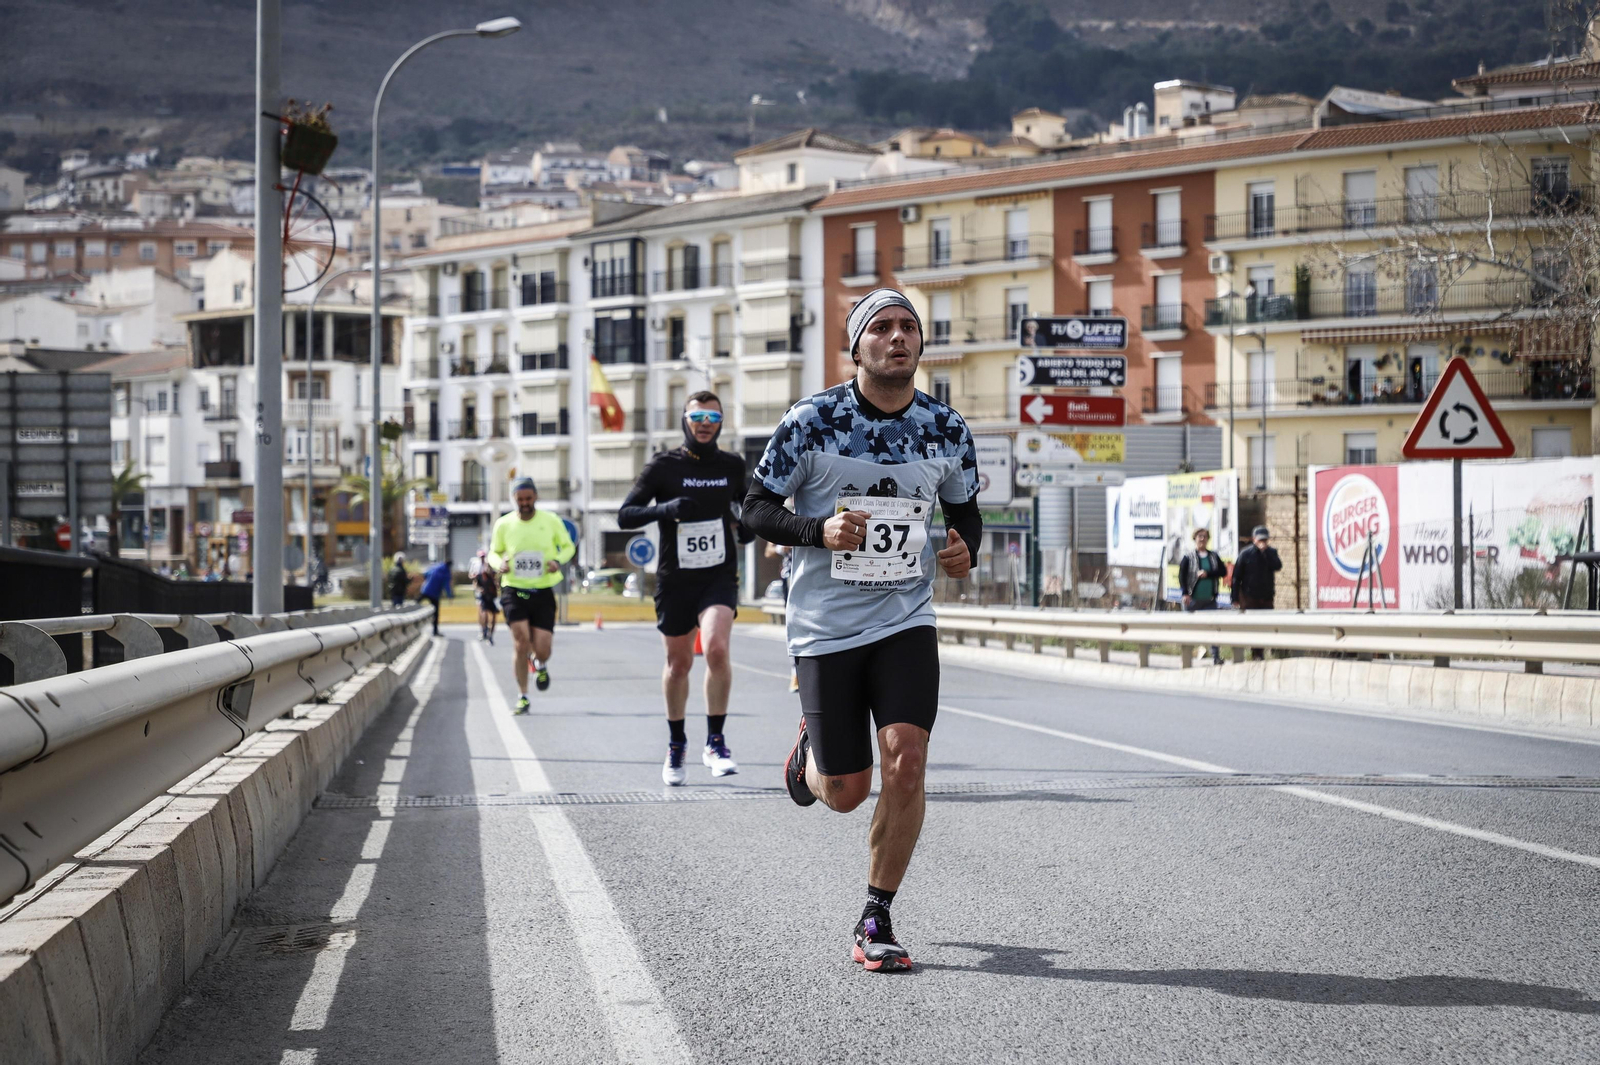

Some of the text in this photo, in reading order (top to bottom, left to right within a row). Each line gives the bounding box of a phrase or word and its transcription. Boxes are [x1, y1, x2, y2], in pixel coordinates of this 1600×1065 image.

[1037, 359, 1122, 368] ABIERTO TODOS LOS
[1072, 369, 1087, 378] DEL
[1067, 412, 1116, 421] Restaurante
[1332, 496, 1377, 530] BURGER
[1335, 513, 1379, 554] KING
[687, 534, 716, 553] 561
